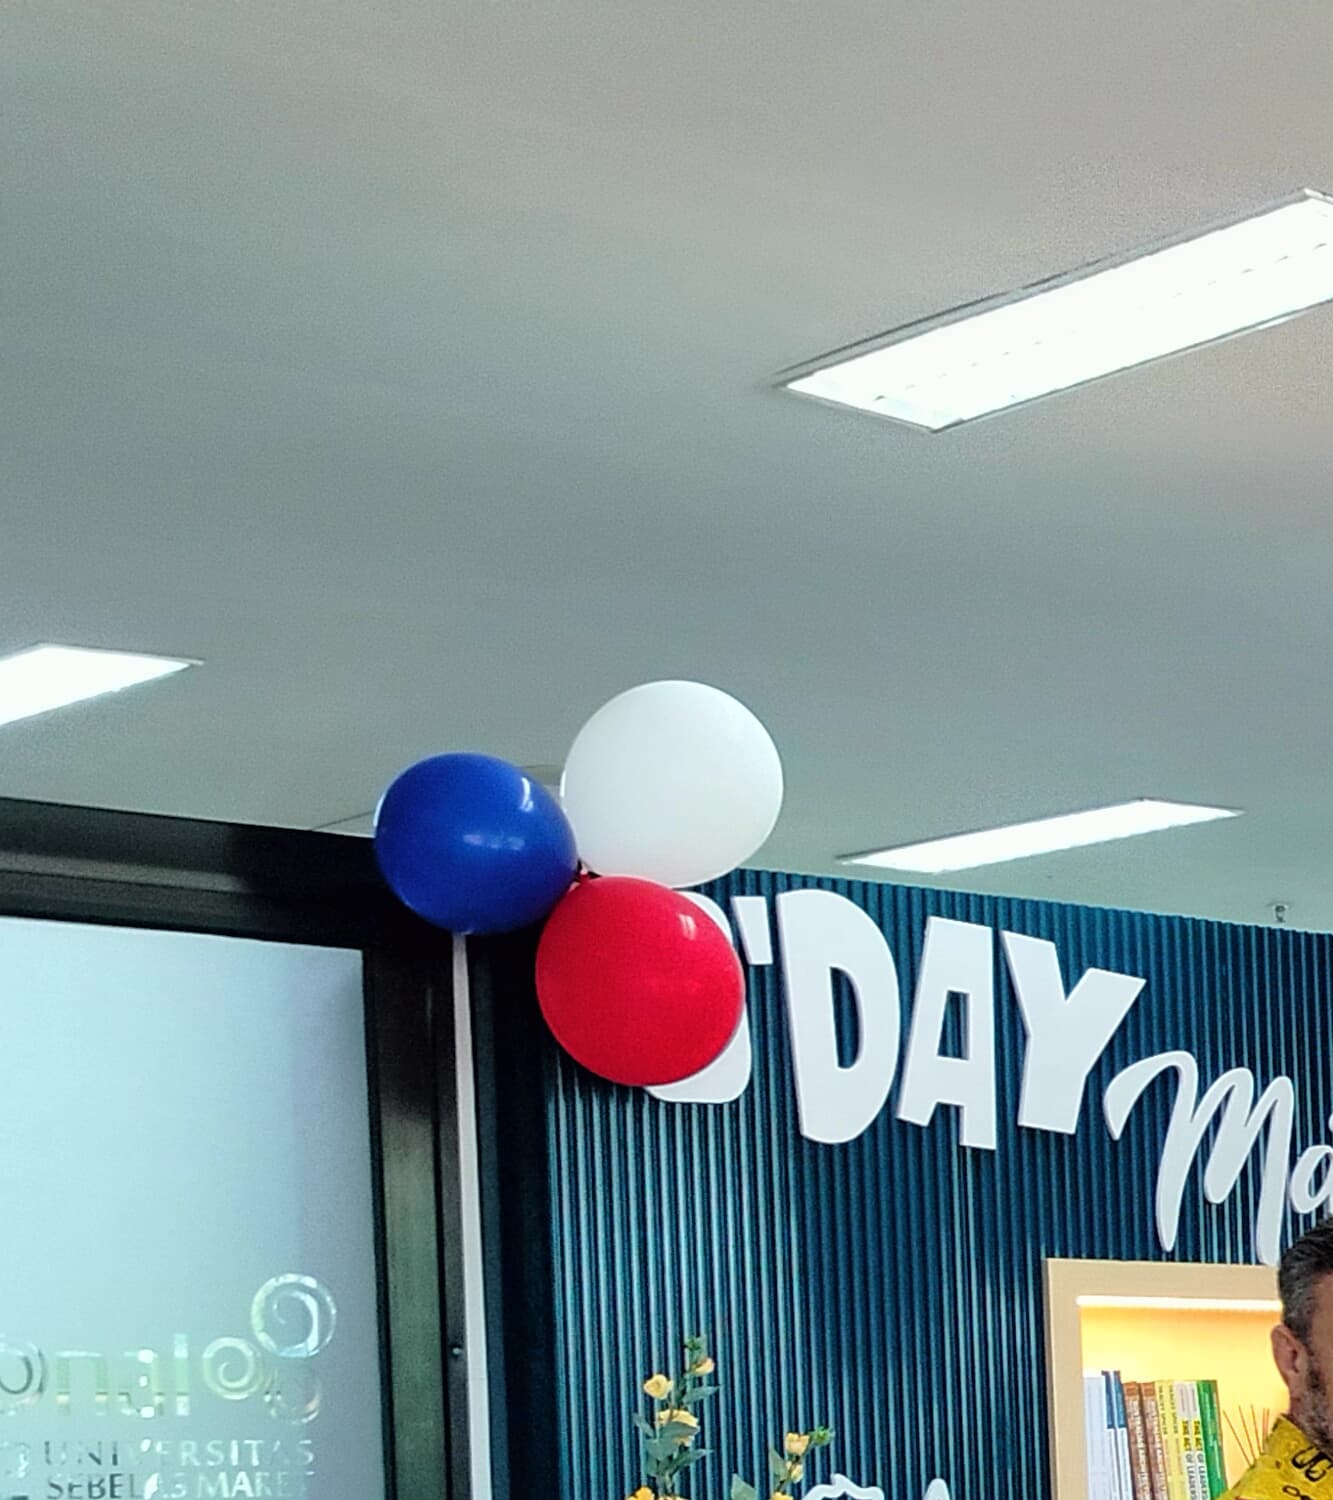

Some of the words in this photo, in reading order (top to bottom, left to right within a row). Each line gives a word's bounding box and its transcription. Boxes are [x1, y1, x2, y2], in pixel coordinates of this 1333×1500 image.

[645, 888, 1146, 1150] 'DAY
[44, 1439, 315, 1466] UNIERSITS
[199, 1471, 315, 1499] MARE
